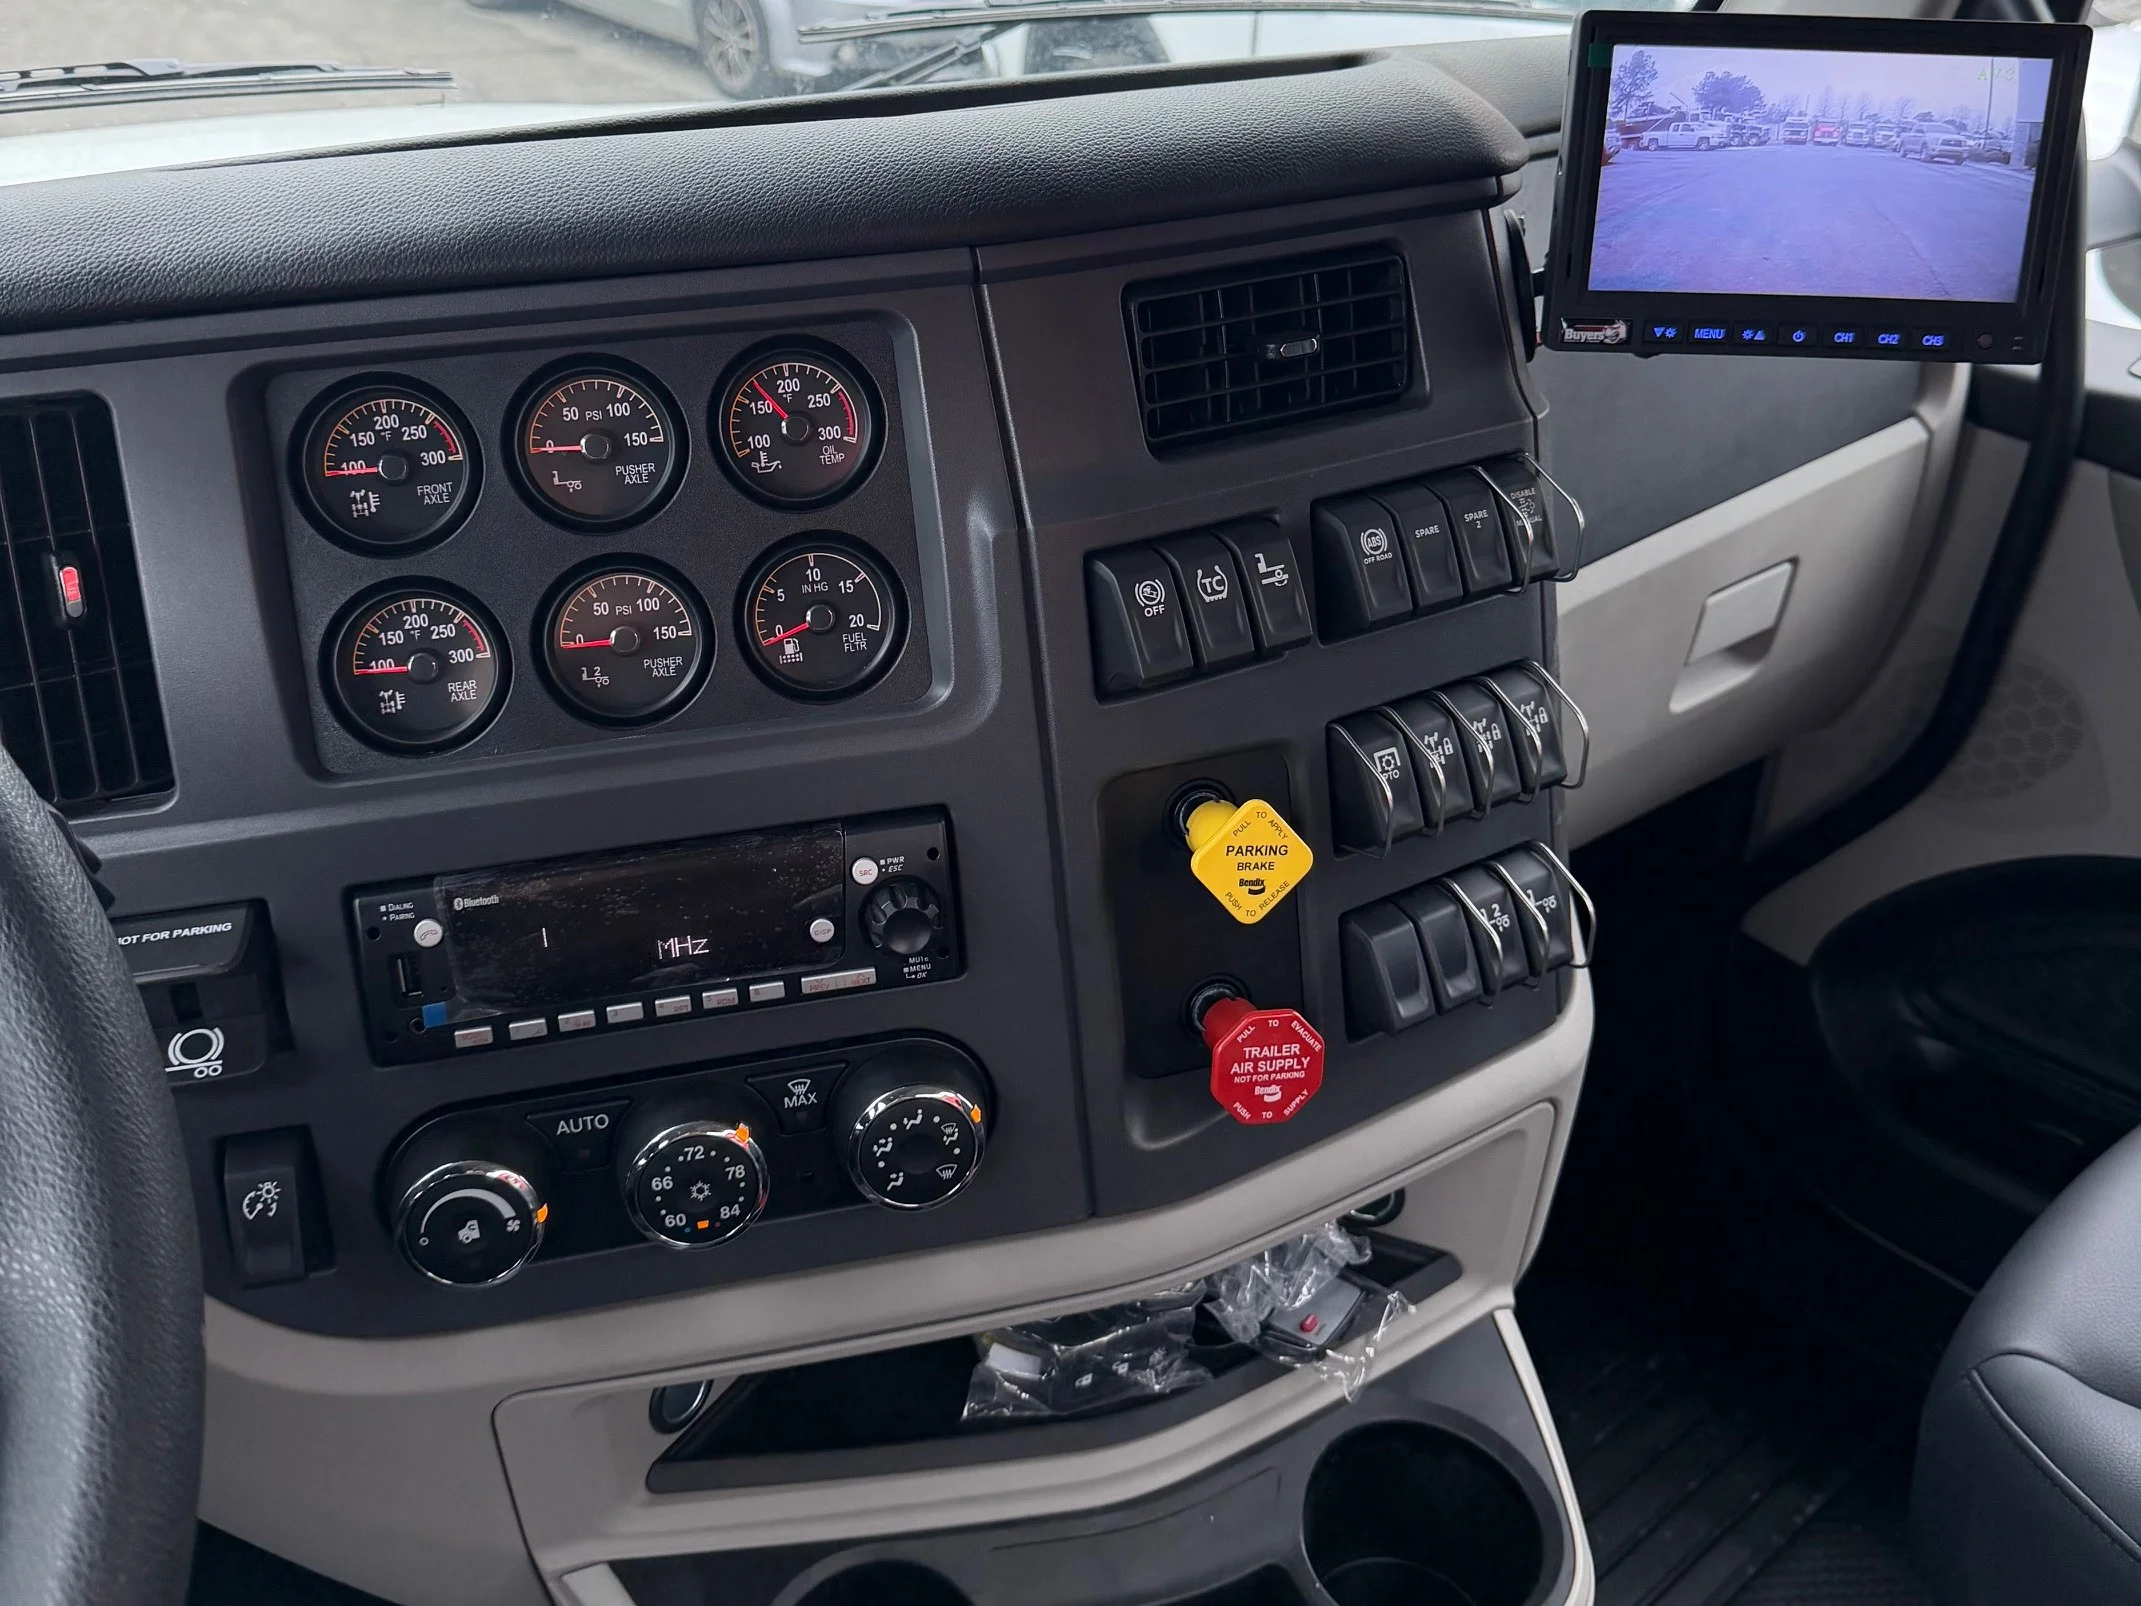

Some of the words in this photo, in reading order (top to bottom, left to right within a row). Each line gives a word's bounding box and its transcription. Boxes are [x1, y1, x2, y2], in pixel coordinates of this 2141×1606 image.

[1564, 328, 1605, 343] Buyers
[1694, 327, 1727, 340] MENU
[1833, 332, 1855, 343] CH1
[1878, 333, 1900, 345] CH2
[1922, 334, 1944, 346] CH3
[777, 378, 800, 394] 200
[750, 400, 772, 415] 150
[807, 393, 831, 408] 250
[562, 407, 579, 421] 50
[585, 410, 603, 421] PSI
[606, 402, 631, 417] 100
[374, 414, 399, 430] 200
[401, 424, 427, 441] 250
[624, 432, 648, 446] 150
[818, 425, 841, 441] 300
[350, 433, 375, 447] 150
[546, 440, 554, 453] 0
[747, 434, 771, 449] 100
[822, 445, 838, 455] OIL
[420, 450, 446, 467] 300
[819, 453, 845, 465] TEMP
[615, 463, 656, 476] PUSHER
[624, 474, 649, 485] AXLE
[417, 482, 453, 496] FRONT
[1511, 487, 1535, 499] DISABLE
[424, 493, 450, 505] AXLE
[1464, 509, 1488, 522] SPARE
[1415, 524, 1440, 538] SPARE
[1476, 520, 1482, 529] 2
[1367, 536, 1381, 548] ABS
[1364, 557, 1375, 565] OFF
[1376, 552, 1392, 562] ROAD
[806, 568, 821, 582] 10
[802, 584, 812, 594] IN
[813, 582, 829, 592] HG
[839, 580, 854, 594] 15
[1201, 575, 1225, 595] TC
[777, 589, 785, 602] 5
[593, 602, 609, 615] 50
[615, 605, 632, 615] PSI
[636, 597, 660, 612] 100
[1144, 604, 1165, 617] OFF
[403, 613, 429, 629] 200
[849, 614, 864, 628] 20
[430, 624, 456, 640] 250
[653, 625, 677, 640] 150
[775, 625, 784, 636] 0
[842, 632, 867, 643] FUEL
[378, 630, 404, 646] 150
[576, 633, 584, 645] 0
[844, 642, 867, 652] FLTR
[448, 648, 474, 664] 300
[643, 656, 683, 669] PUSHER
[652, 667, 677, 678] AXLE
[447, 680, 477, 693] REAR
[450, 689, 477, 702] AXLE
[1232, 820, 1252, 837] PULL
[1256, 811, 1267, 819] TO
[1268, 819, 1288, 840] APPLY
[1225, 844, 1289, 857] PARKING
[886, 856, 905, 865] PWR
[1237, 861, 1275, 871] BRAKE
[859, 869, 873, 877] SRC
[888, 864, 903, 873] ESC
[1239, 878, 1265, 887] Bendix
[463, 894, 500, 908] Bluetooth
[1225, 891, 1242, 911] PUSH
[1245, 909, 1257, 917] TO
[1258, 880, 1290, 911] RELEASE
[141, 931, 171, 943] FOR
[172, 922, 233, 938] PARKING
[657, 935, 710, 960] MHz
[910, 963, 932, 972] MENU
[917, 971, 928, 979] OK
[1236, 1025, 1256, 1043] PULL
[1268, 1019, 1279, 1027] TO
[1291, 1020, 1323, 1052] EVACUATE
[1243, 1043, 1300, 1059] TRAILER
[1230, 1061, 1254, 1075] AIR
[1257, 1056, 1311, 1073] SUPPLY
[1233, 1075, 1251, 1084] NOT
[1252, 1074, 1269, 1082] FOR
[1270, 1070, 1305, 1081] PARKING
[1255, 1084, 1281, 1095] Bendix
[784, 1092, 818, 1109] MAX
[1233, 1101, 1252, 1120] PUSH
[1262, 1111, 1273, 1119] TO
[1283, 1088, 1309, 1116] SUPPLY
[556, 1113, 610, 1136] AUTO
[684, 1145, 705, 1161] 72
[725, 1164, 746, 1181] 78
[651, 1175, 674, 1191] 66
[719, 1203, 741, 1220] 84
[665, 1213, 687, 1228] 60
